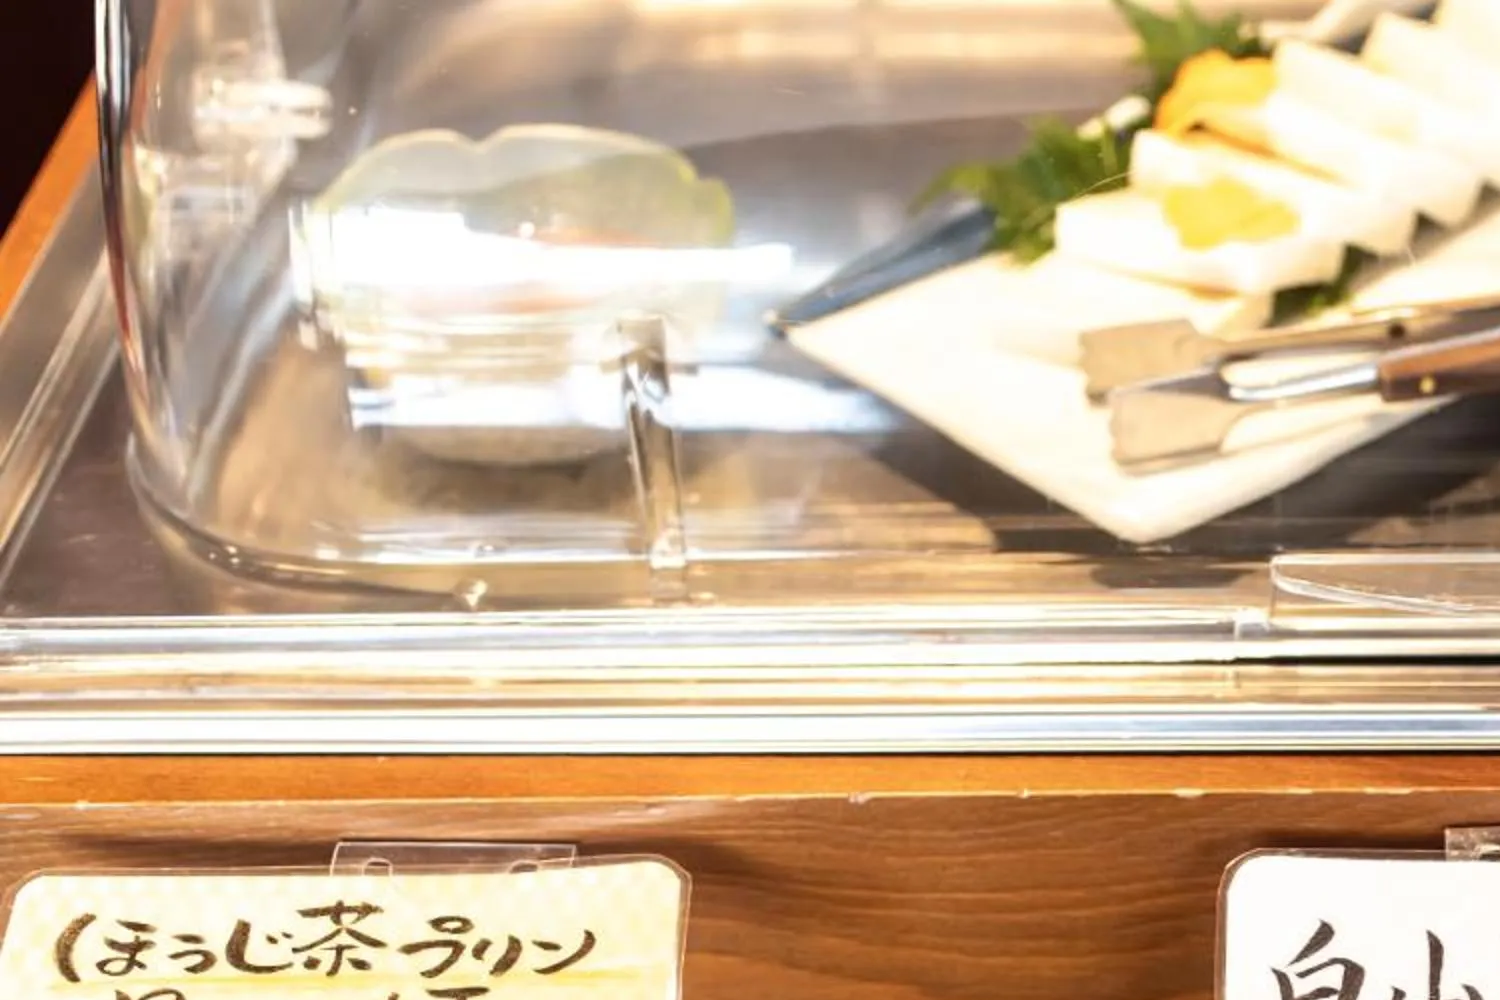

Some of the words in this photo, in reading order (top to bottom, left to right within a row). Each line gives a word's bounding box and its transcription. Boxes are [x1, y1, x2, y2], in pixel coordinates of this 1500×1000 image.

[54, 900, 597, 984] ほうじ茶プリン
